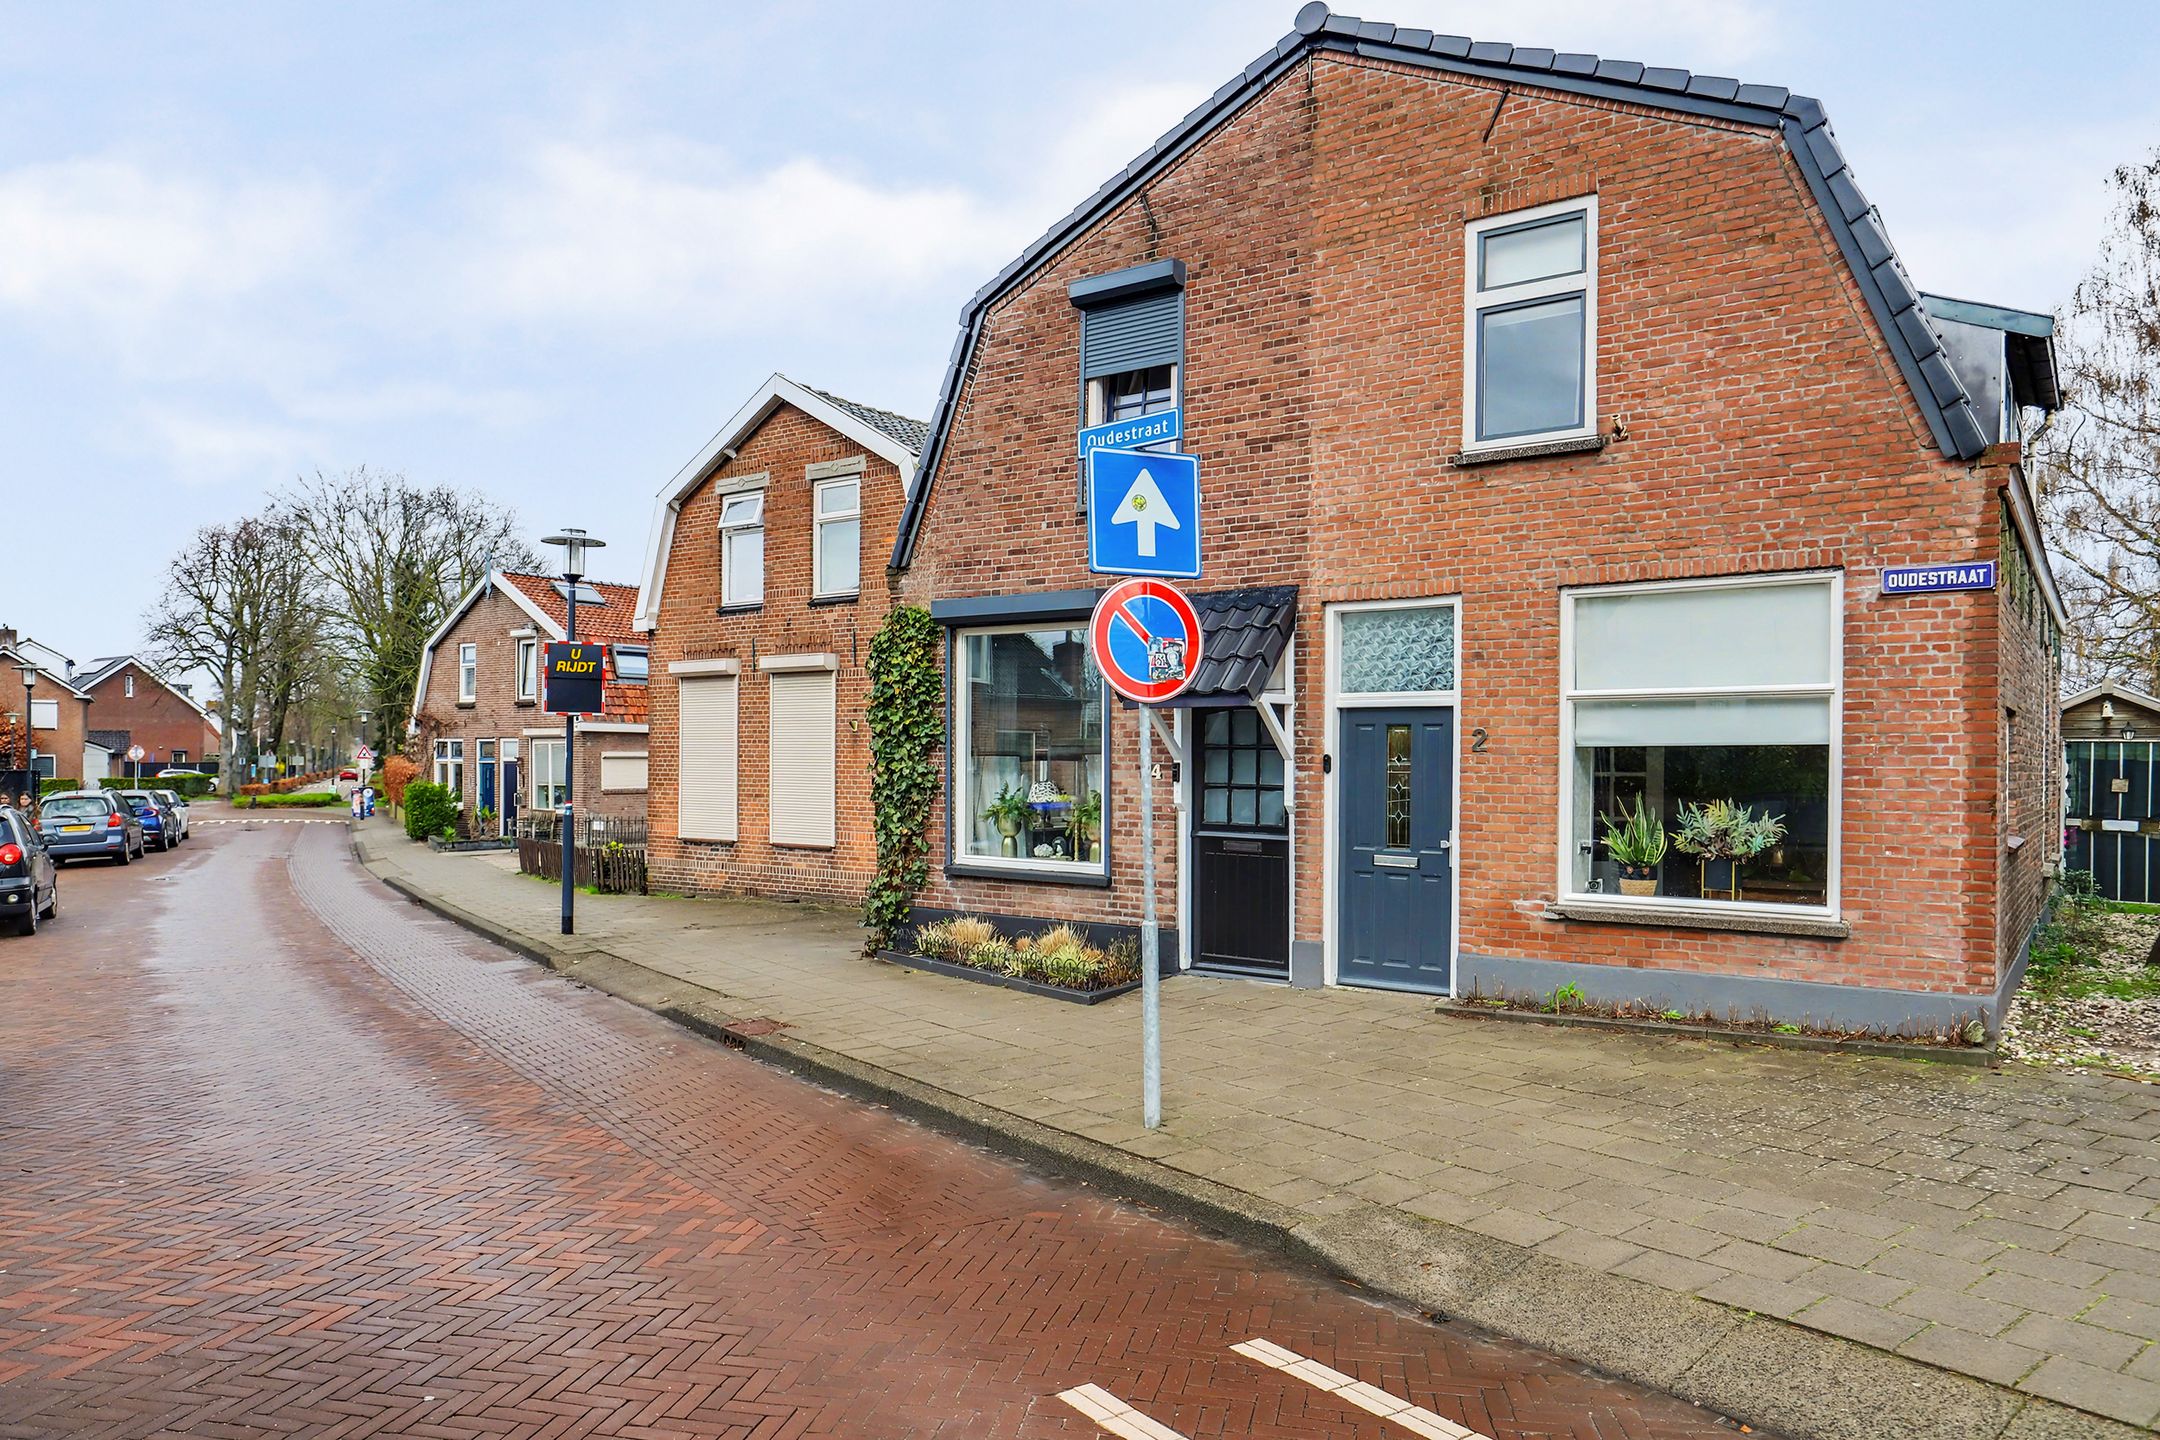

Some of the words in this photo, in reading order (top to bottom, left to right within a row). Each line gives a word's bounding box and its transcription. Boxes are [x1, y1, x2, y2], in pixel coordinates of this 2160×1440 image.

[1087, 420, 1168, 446] Oudestraat
[1888, 568, 1987, 588] OUDESTRAAT
[571, 648, 582, 660] U
[555, 661, 597, 673] RIJDT
[1472, 727, 1488, 752] 2
[1151, 763, 1162, 780] 4
